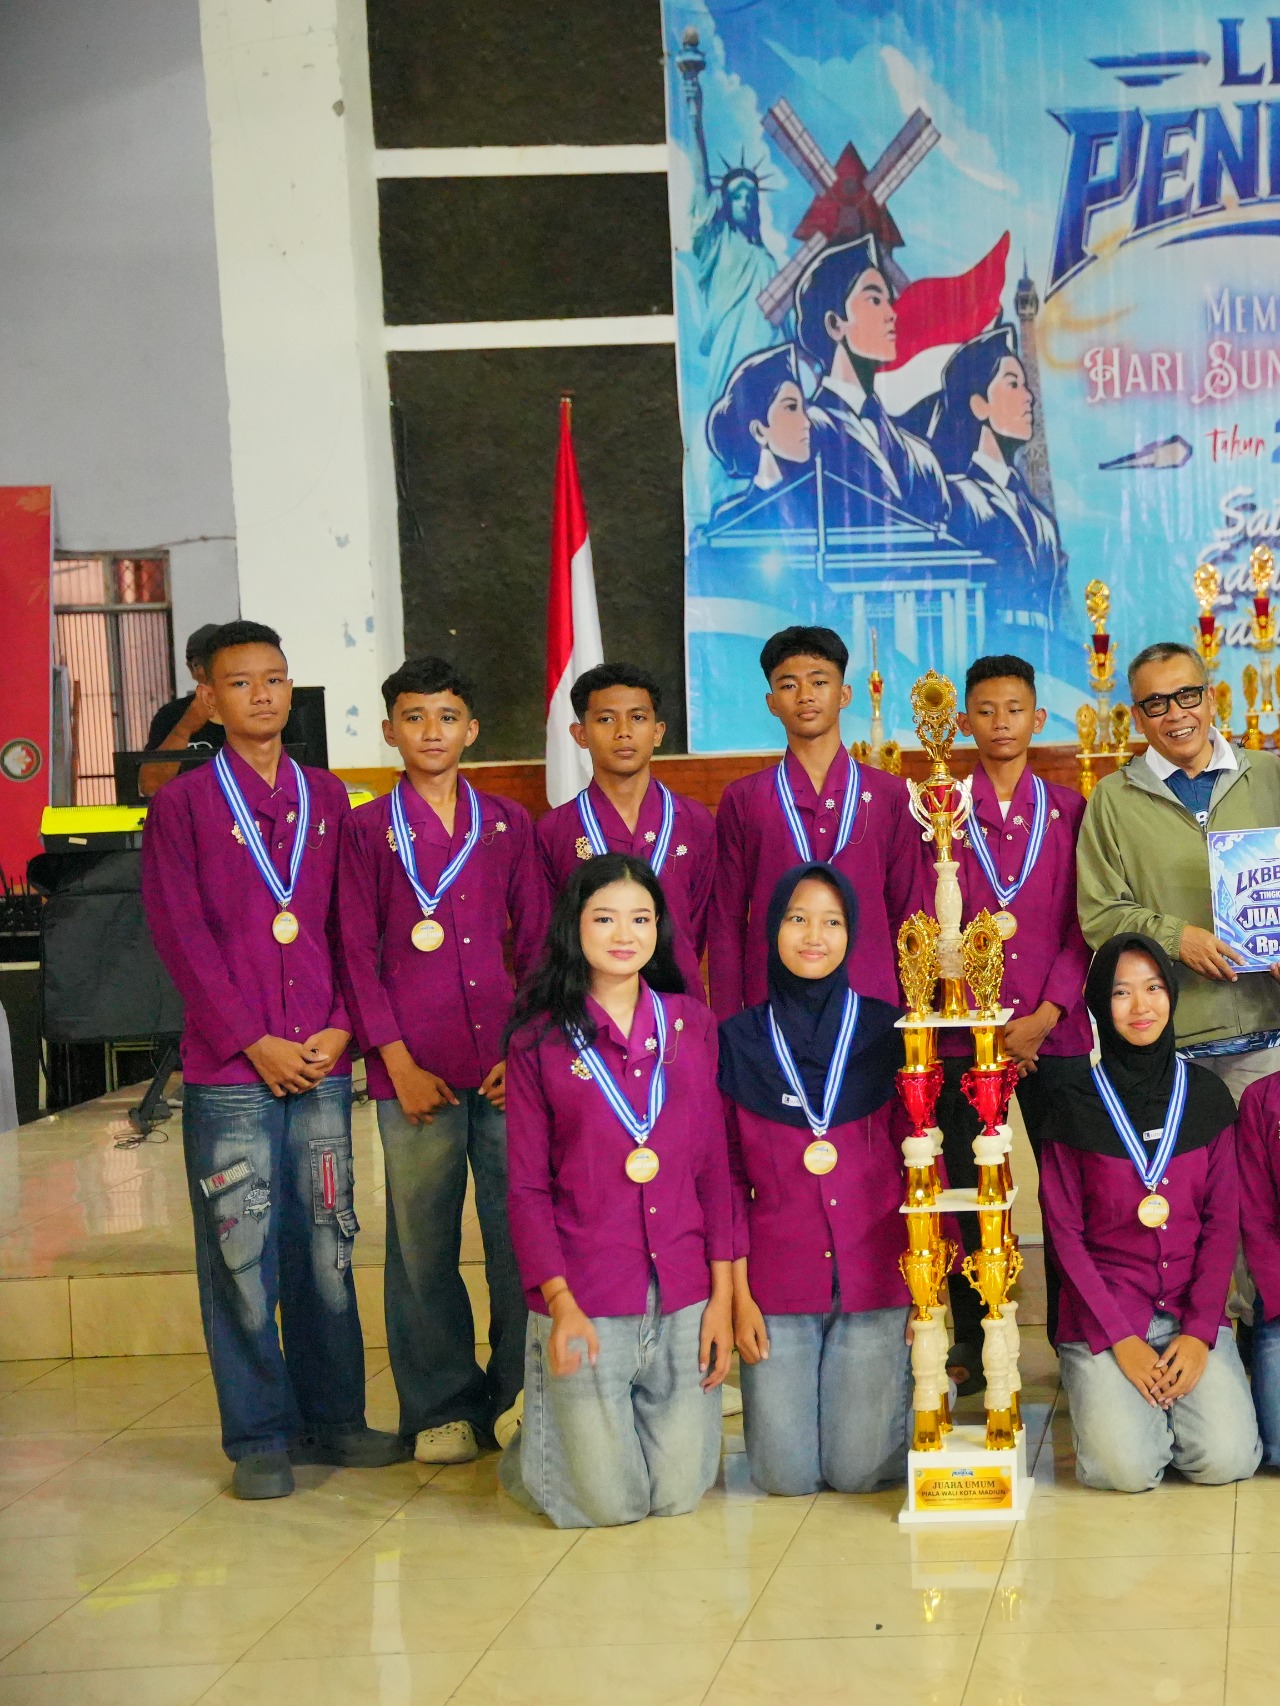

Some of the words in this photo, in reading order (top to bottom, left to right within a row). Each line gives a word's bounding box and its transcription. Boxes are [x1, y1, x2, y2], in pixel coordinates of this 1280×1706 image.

[1083, 344, 1184, 403] HARI
[932, 1481, 963, 1490] JUARA
[966, 1480, 995, 1488] UMUM
